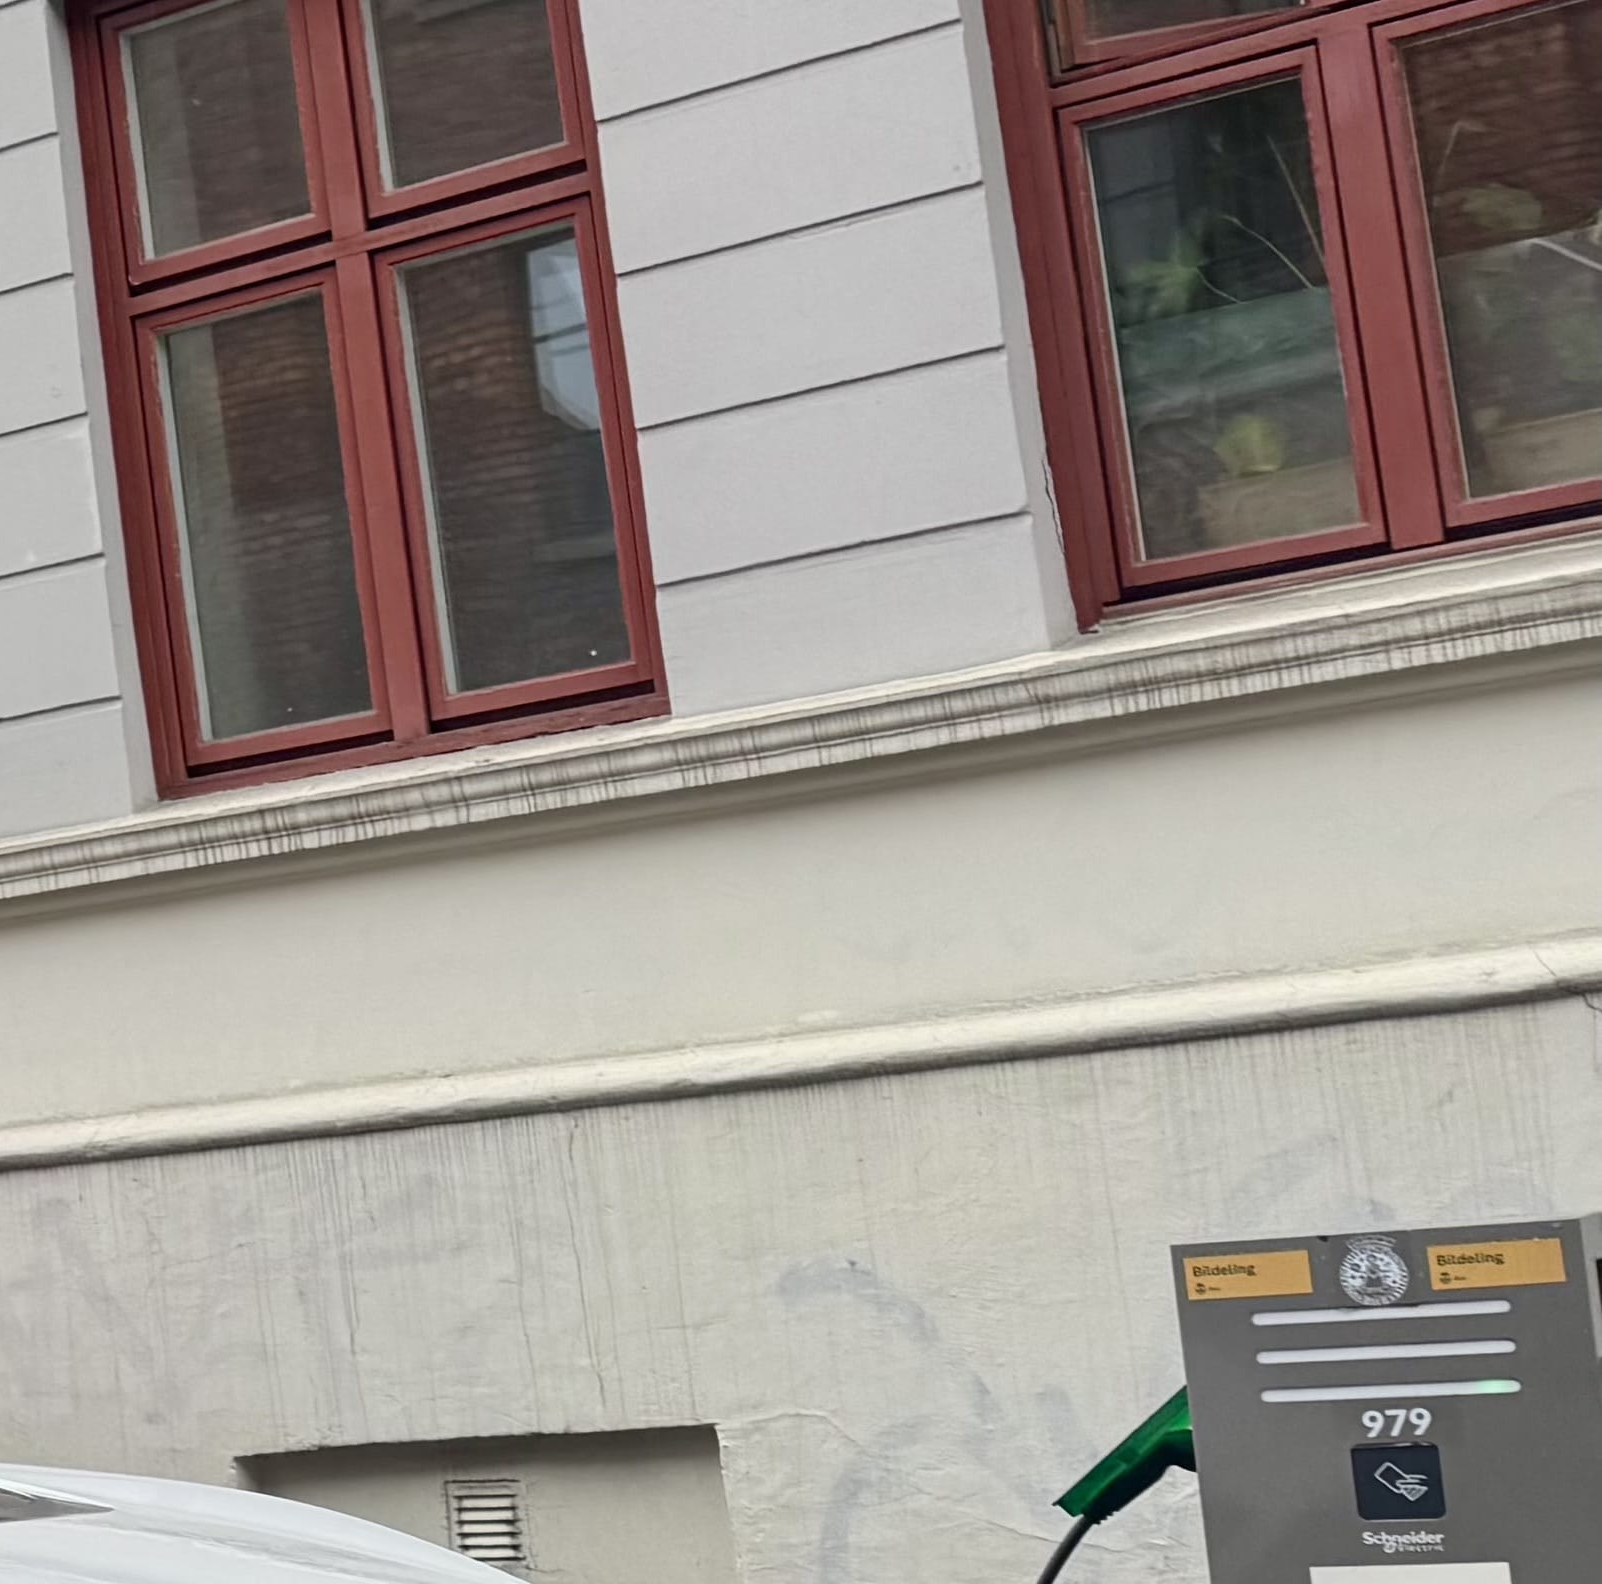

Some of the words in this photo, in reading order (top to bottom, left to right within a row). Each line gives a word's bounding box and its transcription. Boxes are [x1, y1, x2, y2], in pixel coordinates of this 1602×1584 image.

[1435, 1252, 1506, 1266] Bildeling
[1192, 1263, 1258, 1278] Bildeling
[1361, 1407, 1433, 1438] 979
[1362, 1530, 1446, 1547] Schneider
